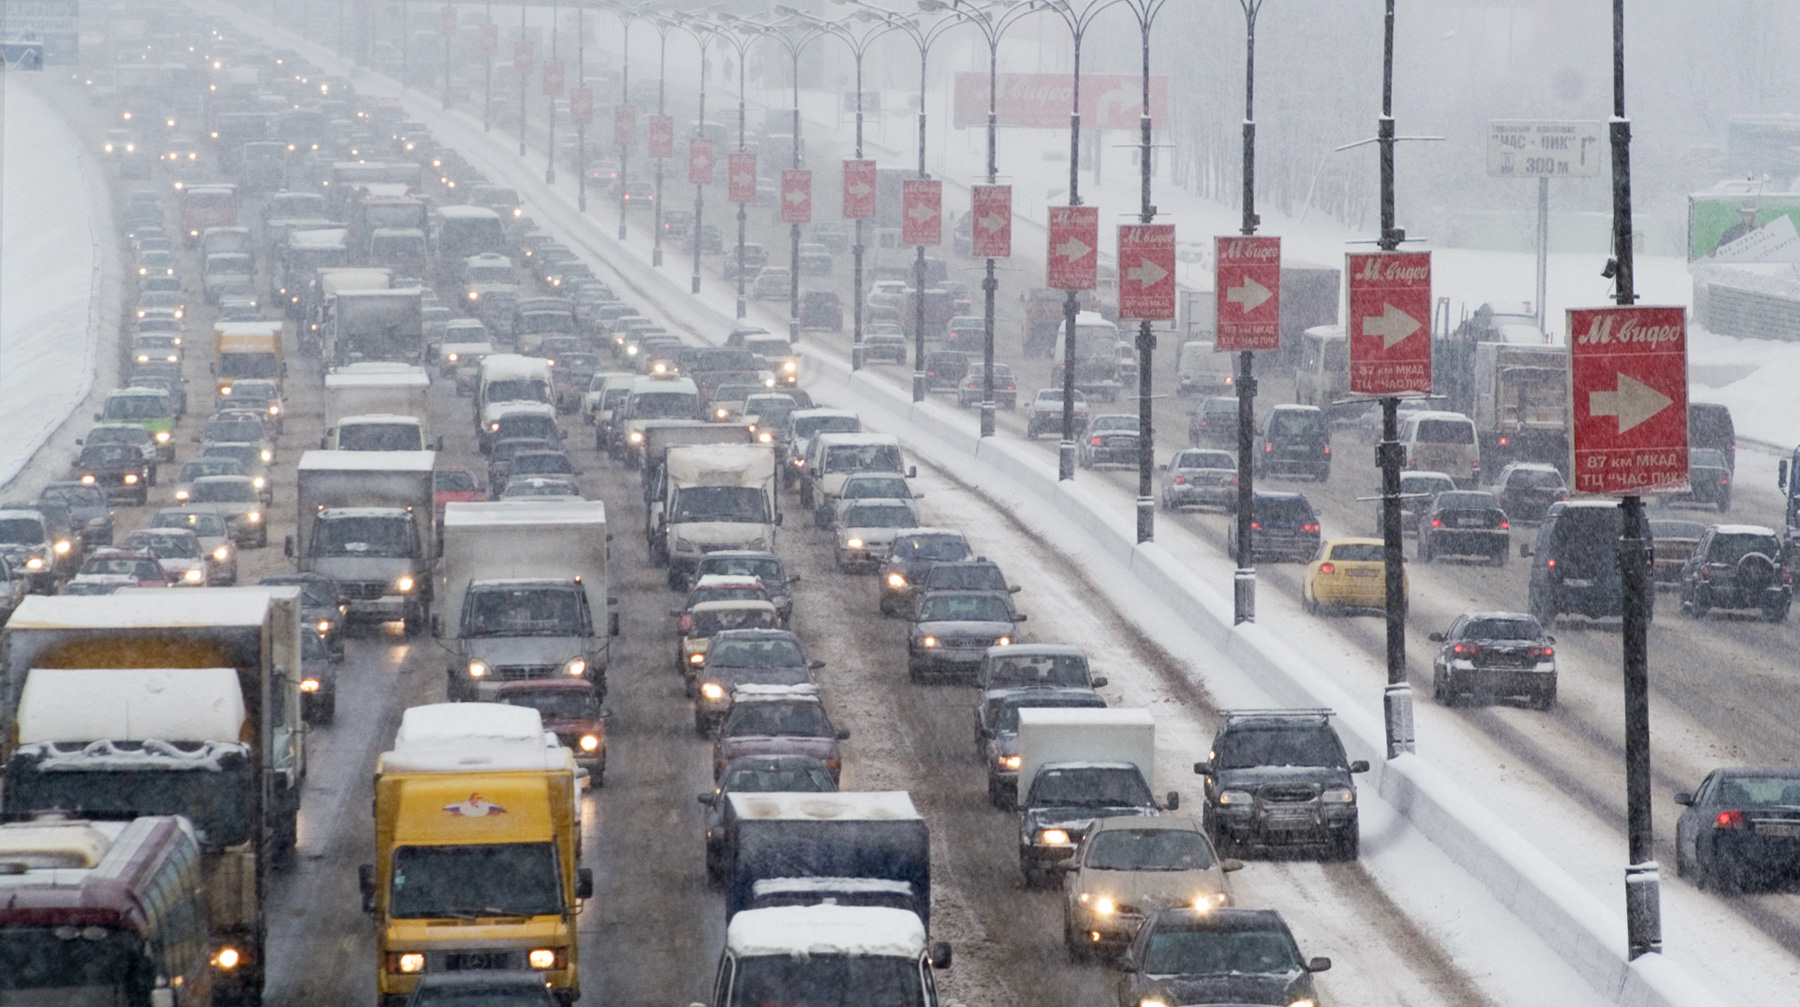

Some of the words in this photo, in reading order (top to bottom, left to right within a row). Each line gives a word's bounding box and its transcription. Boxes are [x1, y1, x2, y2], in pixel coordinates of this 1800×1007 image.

[1525, 157, 1555, 174] 300
[1220, 240, 1279, 262] М.видео
[1355, 257, 1429, 285] М.видео
[1578, 314, 1681, 349] М.видео
[1359, 366, 1374, 376] 87
[1377, 367, 1393, 375] км
[1395, 365, 1425, 376] МКАД
[1355, 379, 1372, 391] ТЦ
[1587, 455, 1607, 469] 87
[1611, 457, 1632, 468] км
[1636, 453, 1678, 468] МКАД
[1581, 473, 1604, 488] ТЦ
